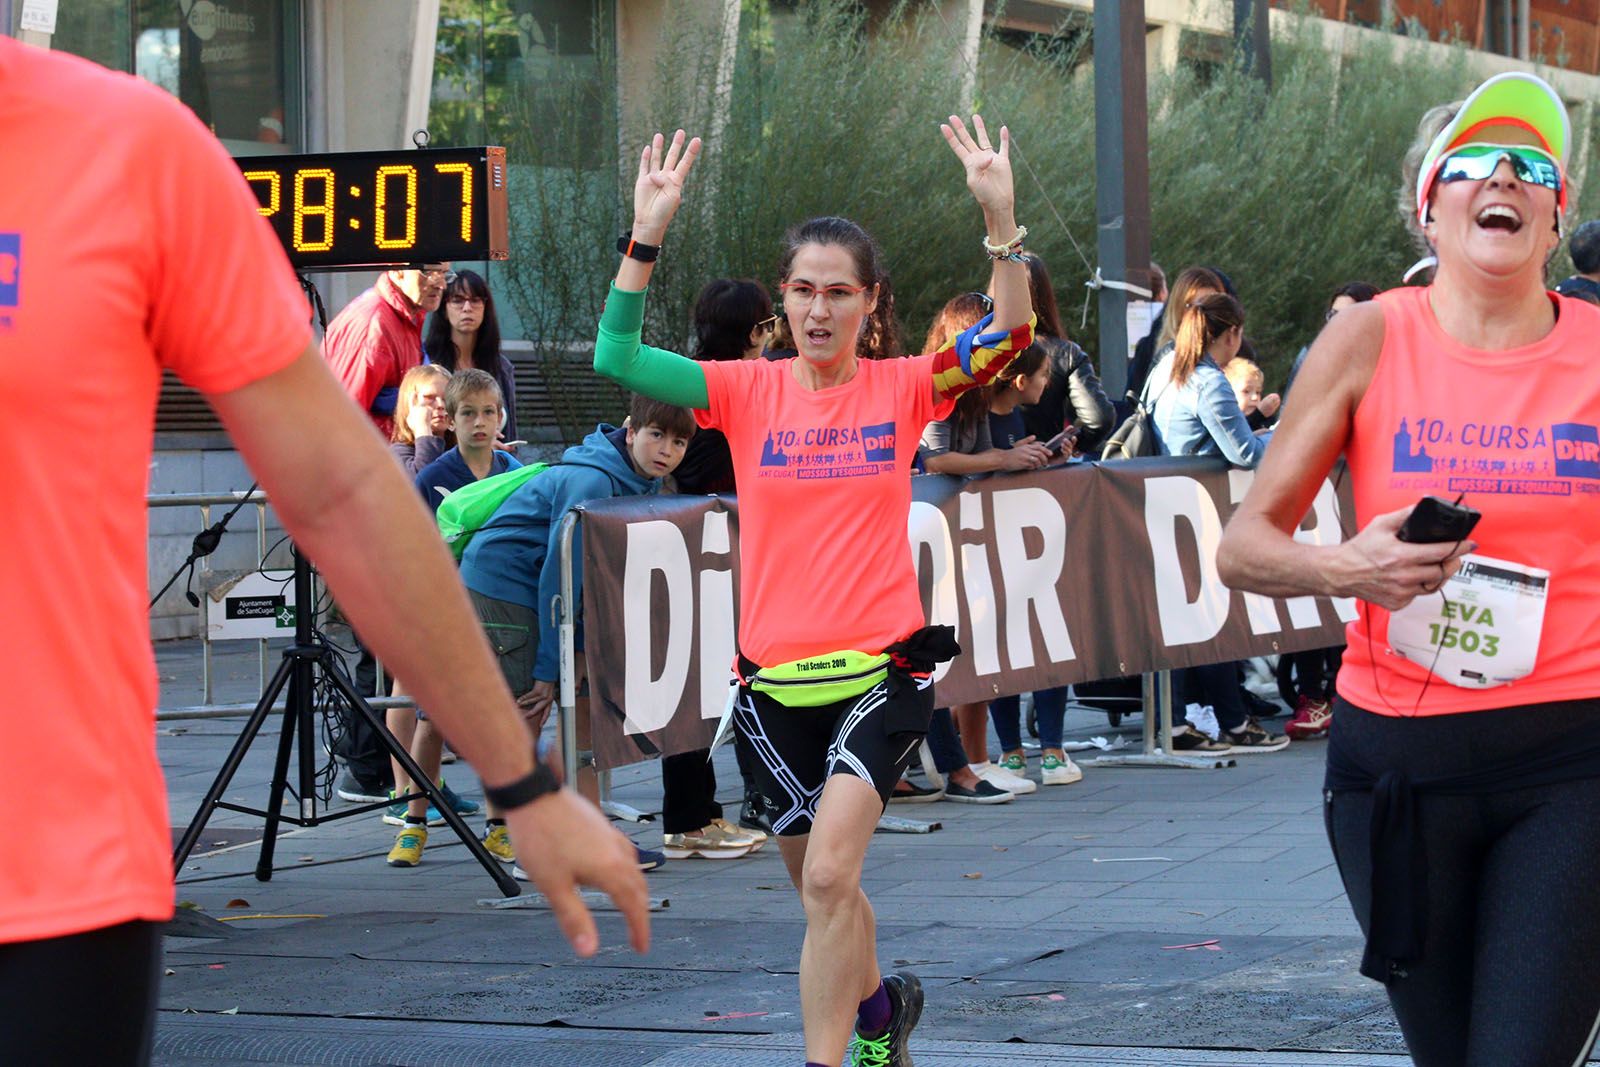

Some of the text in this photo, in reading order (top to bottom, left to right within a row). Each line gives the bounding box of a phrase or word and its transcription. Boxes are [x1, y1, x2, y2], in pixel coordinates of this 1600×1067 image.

[804, 428, 859, 446] CURSA
[864, 434, 895, 451] DiR
[1461, 423, 1547, 449] CURSA
[1555, 439, 1600, 463] DiR
[799, 468, 831, 478] MOSSOS
[831, 465, 878, 477] D'ESQUADRA
[1450, 479, 1498, 493] MOSSOS
[907, 487, 1077, 684] DiR
[239, 600, 272, 608] Ajuntament
[1441, 600, 1495, 627] EVA
[623, 510, 736, 736] Di
[1429, 623, 1500, 657] 1503
[797, 658, 846, 671] Trail Senders 2016
